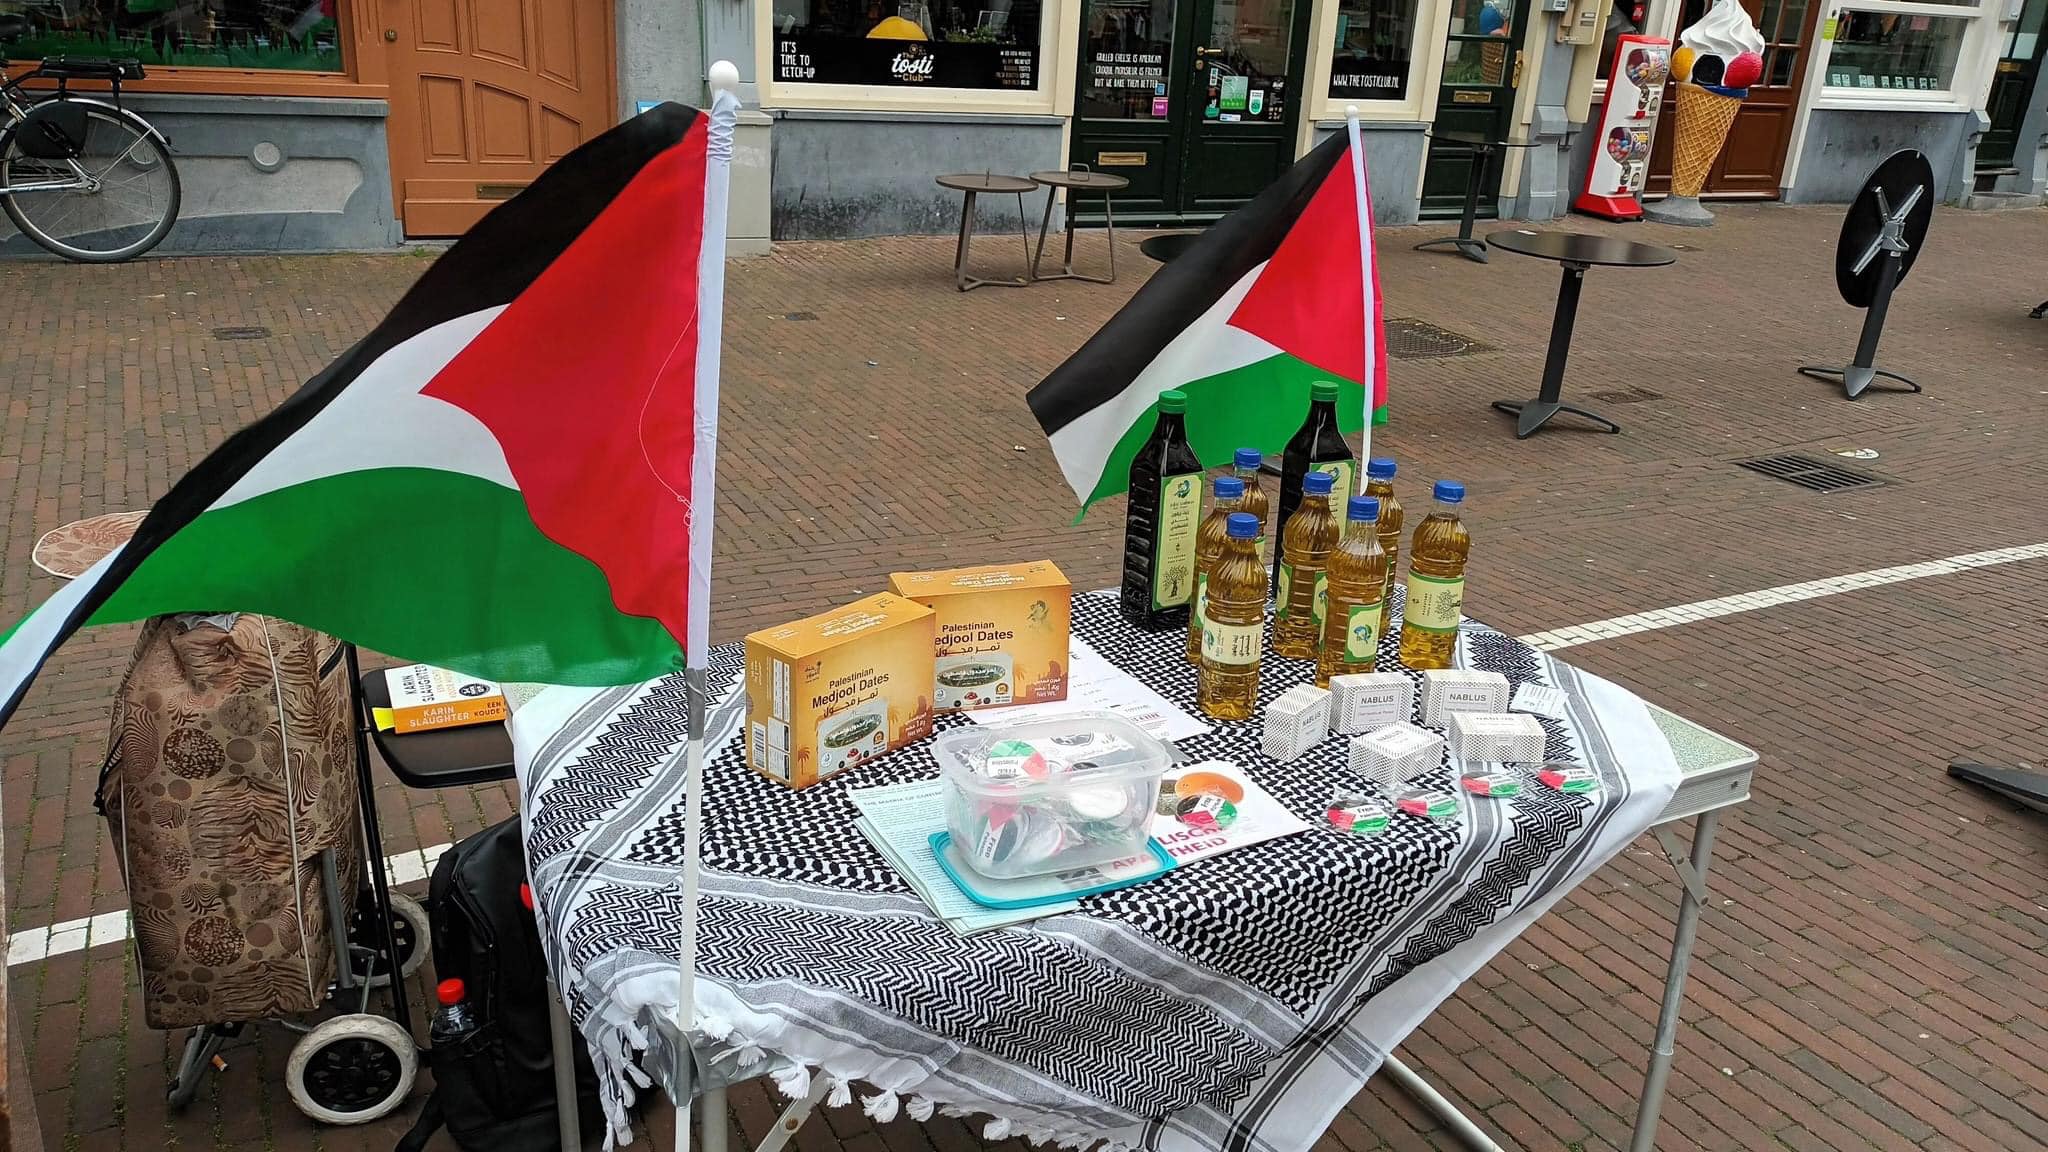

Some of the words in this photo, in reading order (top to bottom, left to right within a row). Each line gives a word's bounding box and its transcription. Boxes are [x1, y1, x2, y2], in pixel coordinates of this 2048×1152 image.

[781, 41, 796, 53] IT'S
[780, 54, 797, 66] TIME
[800, 54, 810, 66] TO
[891, 53, 935, 74] tosti
[1132, 54, 1138, 63] IS
[1138, 66, 1144, 76] IS
[902, 73, 924, 82] Club
[942, 621, 995, 633] Palestinian
[935, 632, 973, 647] edjool
[977, 630, 1014, 643] Dates
[828, 667, 874, 689] Palestinian
[812, 683, 857, 709] Medjool
[859, 672, 890, 691] Dates
[1360, 694, 1394, 705] NABLUS
[1449, 692, 1487, 702] NABLUS
[486, 701, 501, 709] EEN
[423, 705, 456, 718] KARIN
[474, 708, 500, 717] KOUDE
[409, 712, 470, 728] SLAUGHTER
